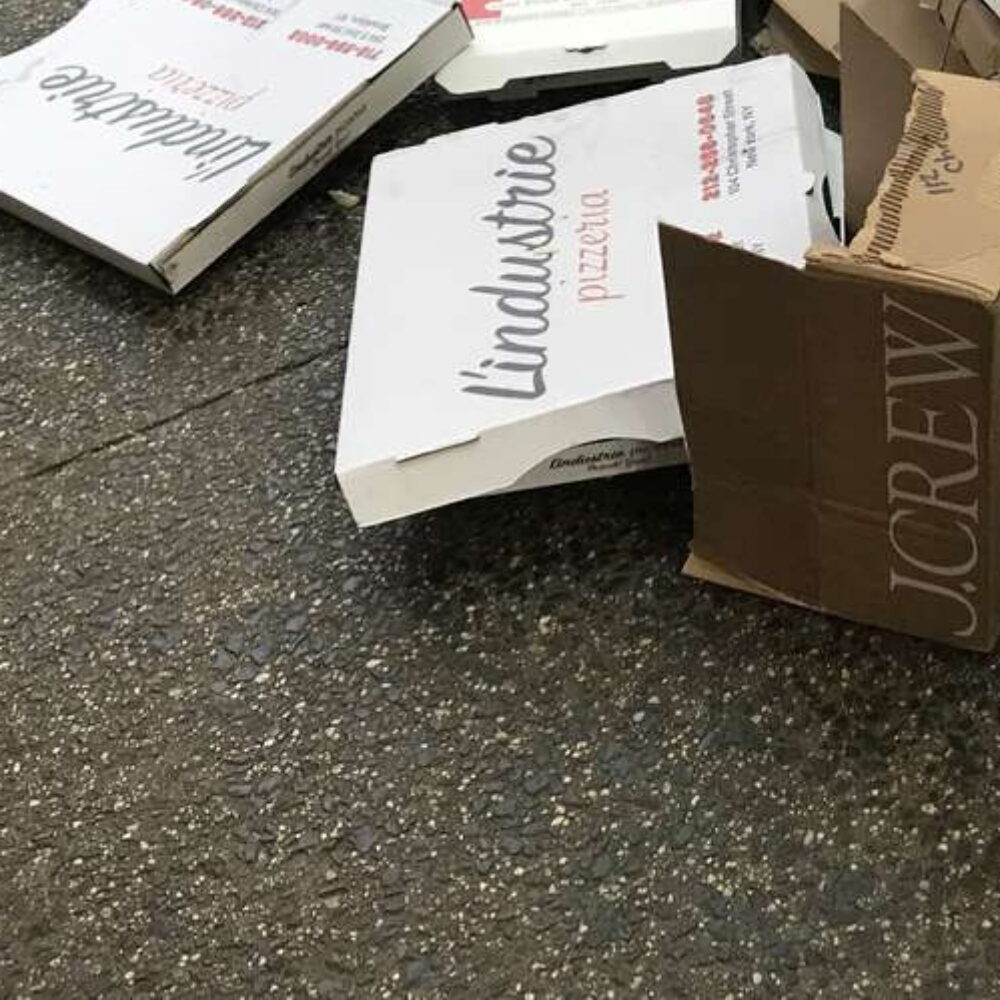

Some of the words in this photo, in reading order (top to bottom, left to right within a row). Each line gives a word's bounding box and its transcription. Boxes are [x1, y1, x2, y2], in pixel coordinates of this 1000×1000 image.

[459, 135, 557, 400] L'industrie
[577, 189, 625, 304] pizzeria
[883, 293, 981, 637] J.CREW
